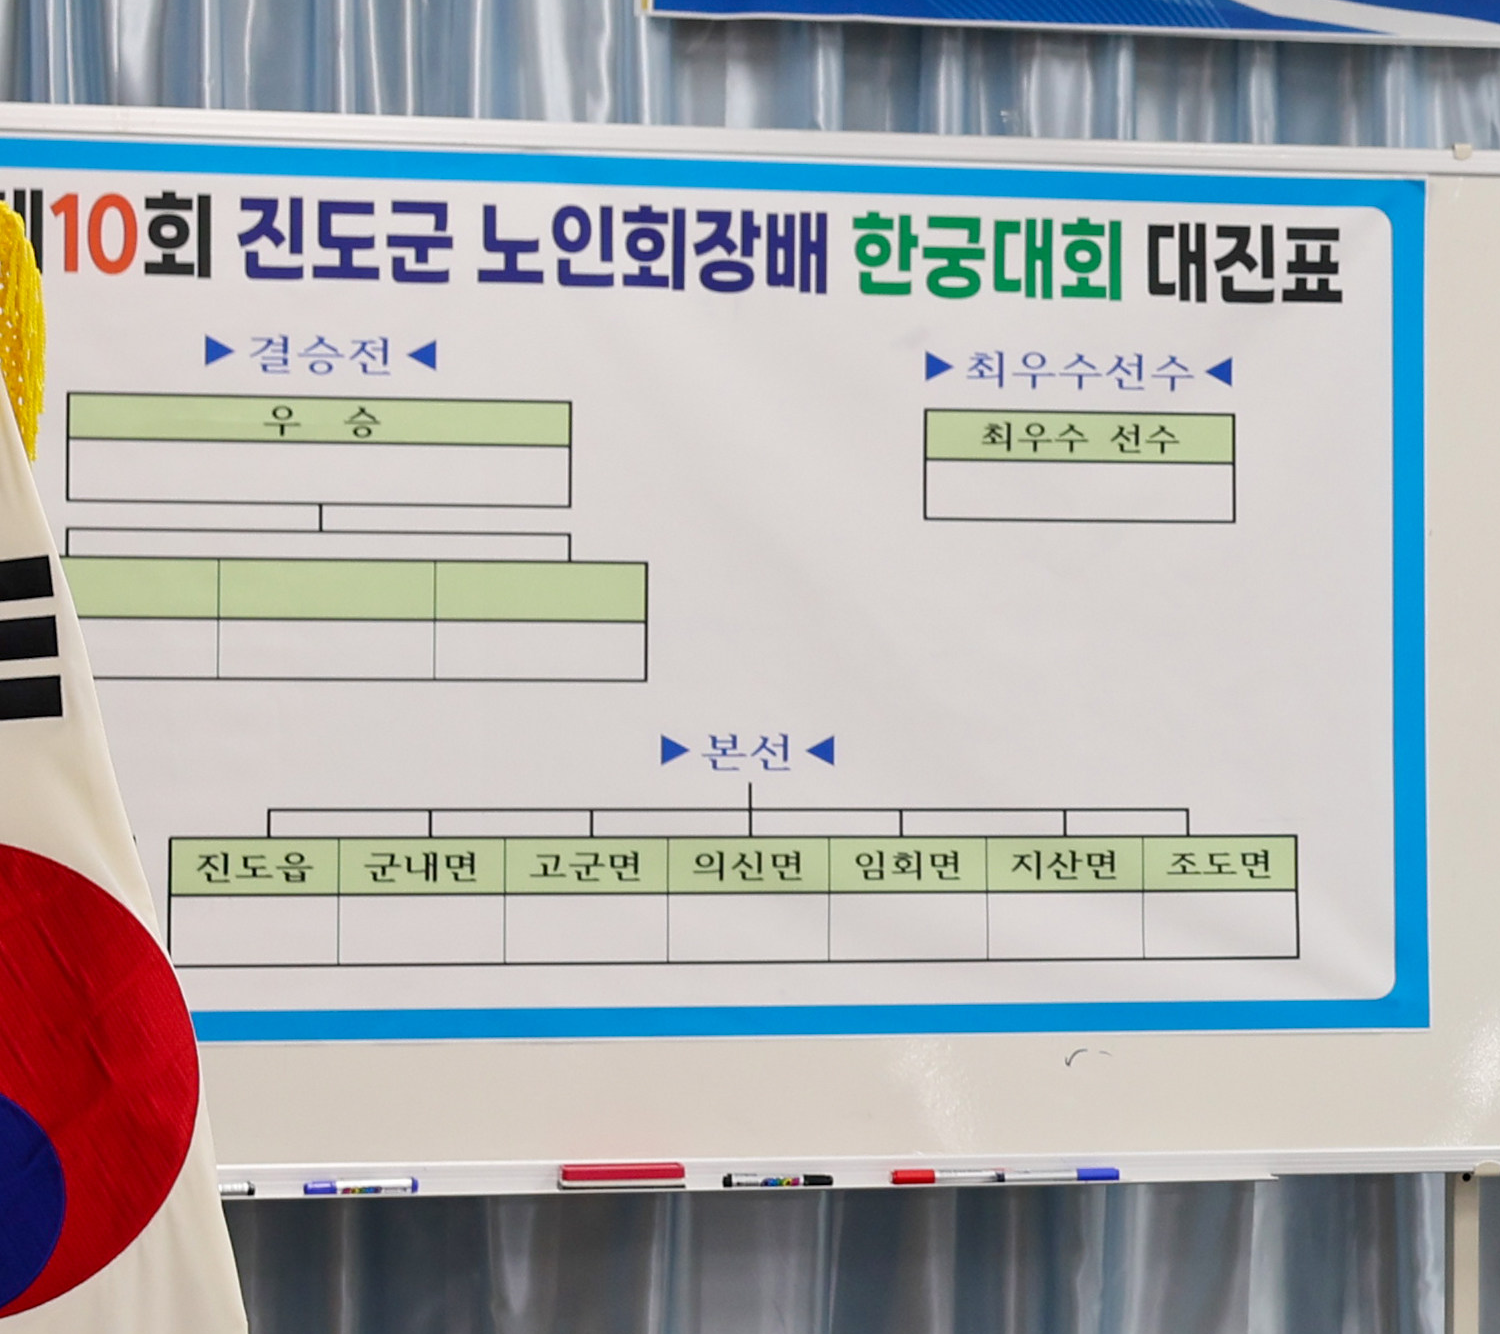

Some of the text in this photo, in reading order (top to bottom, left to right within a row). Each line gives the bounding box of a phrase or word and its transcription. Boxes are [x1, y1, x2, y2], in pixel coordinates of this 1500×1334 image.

[238, 197, 453, 283] 진도군
[478, 205, 827, 294] 노인회장배
[853, 212, 1122, 301] 한궁대회
[1148, 223, 1342, 304] 대진표
[256, 336, 388, 374] 결승전
[970, 352, 1193, 391] 최우수선수
[983, 422, 1179, 454] 최우수 선수
[704, 734, 789, 770] 본선
[198, 850, 1270, 883] 진도읍 군내면 고군면 의신면 임회면 지산면 조도면
